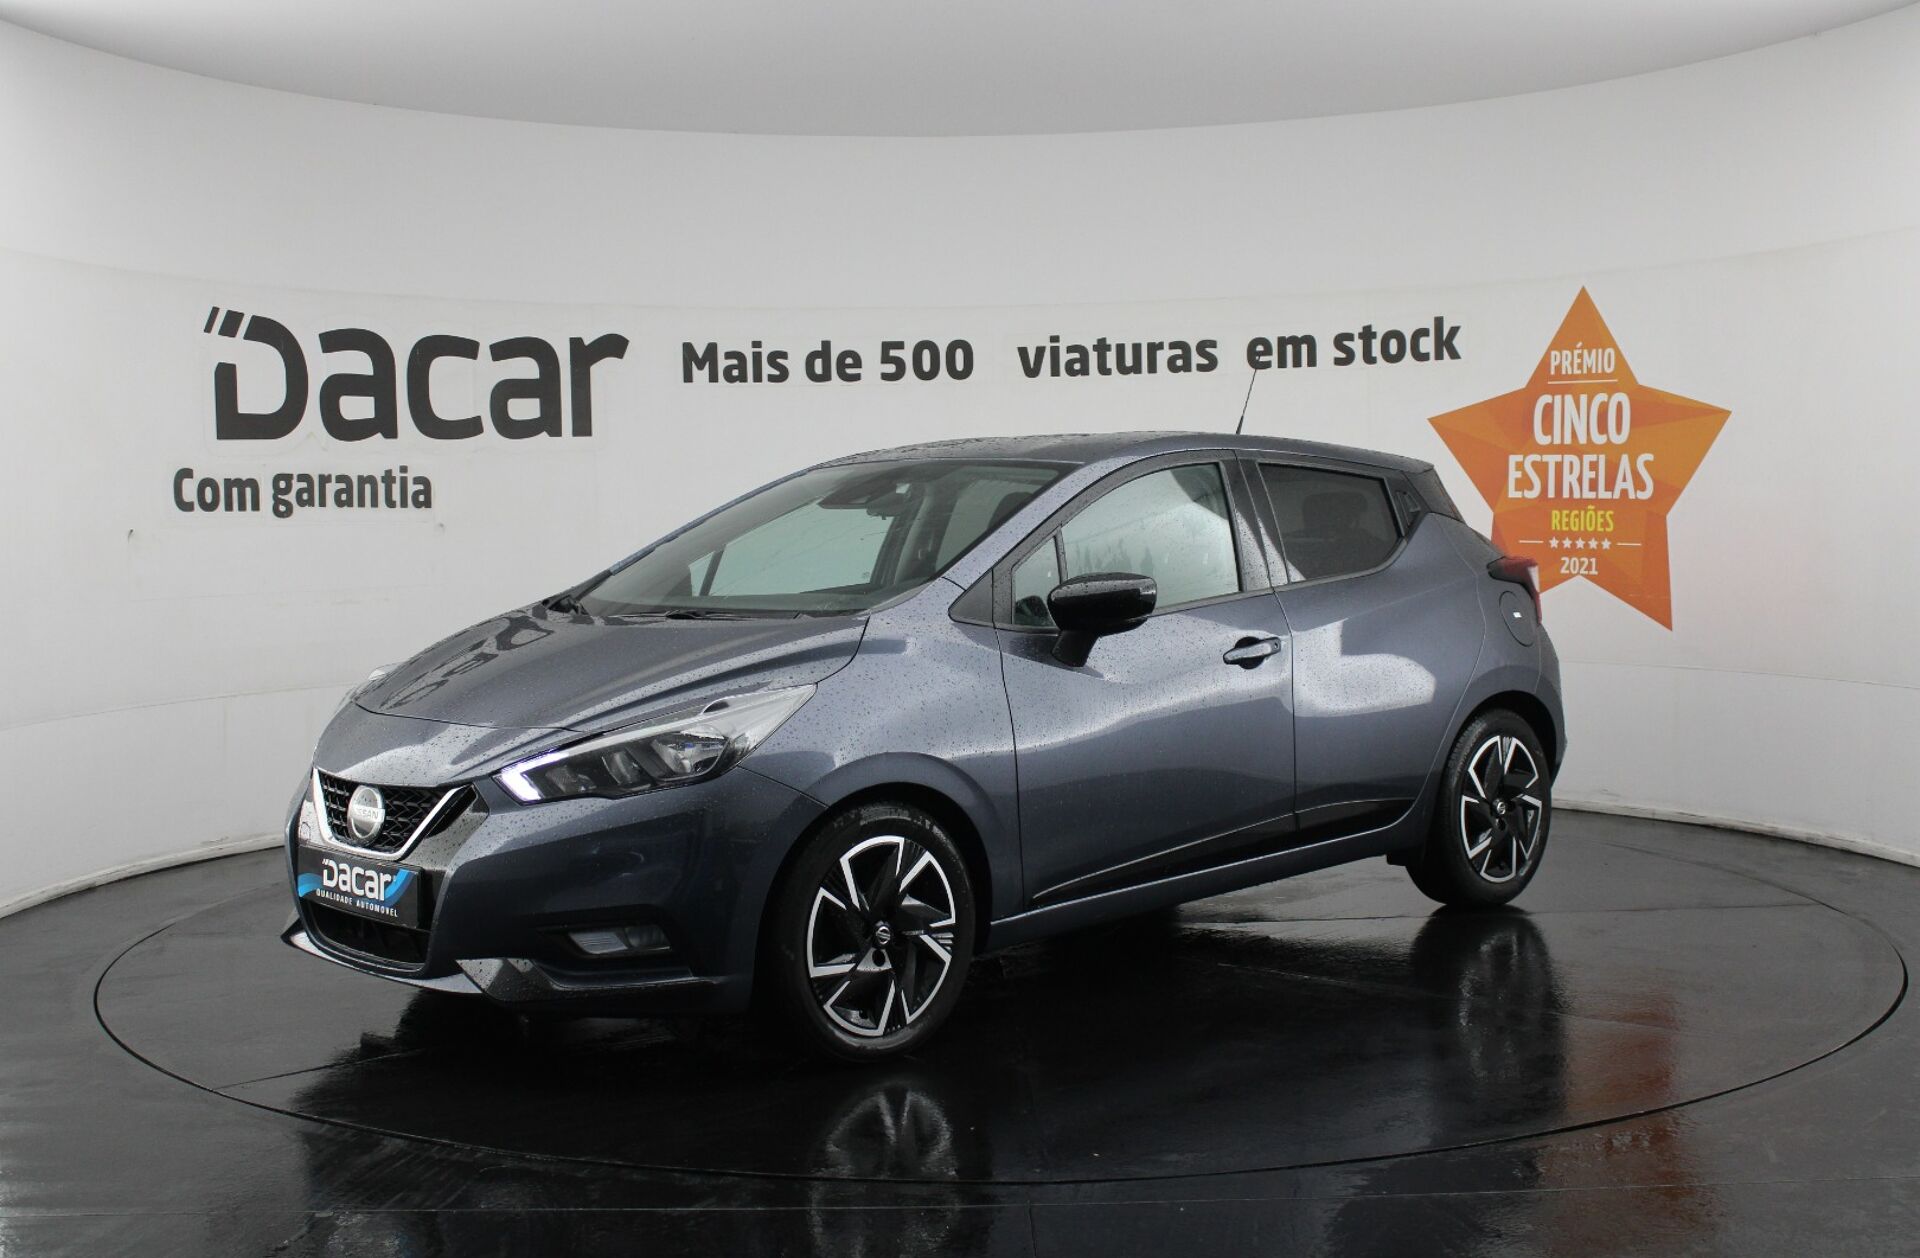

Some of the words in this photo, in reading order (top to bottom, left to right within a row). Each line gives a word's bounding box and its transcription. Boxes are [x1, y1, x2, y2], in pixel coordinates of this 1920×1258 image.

[682, 340, 790, 384] Mais
[805, 340, 863, 383] de
[880, 339, 974, 382] 500
[1018, 334, 1219, 379] viaturas
[1246, 336, 1317, 370] em
[1333, 315, 1462, 367] stock
[1549, 342, 1615, 375] PRÉMIO
[204, 306, 630, 442] Dacar
[1533, 392, 1631, 446] CINCO
[173, 467, 260, 513] Com
[272, 465, 433, 518] garantia
[1507, 453, 1655, 500] ESTRELAS
[1551, 506, 1614, 532] REGIÕES
[1560, 556, 1598, 575] 2021
[316, 888, 353, 905] QUALIDADE
[322, 858, 392, 901] Dacar
